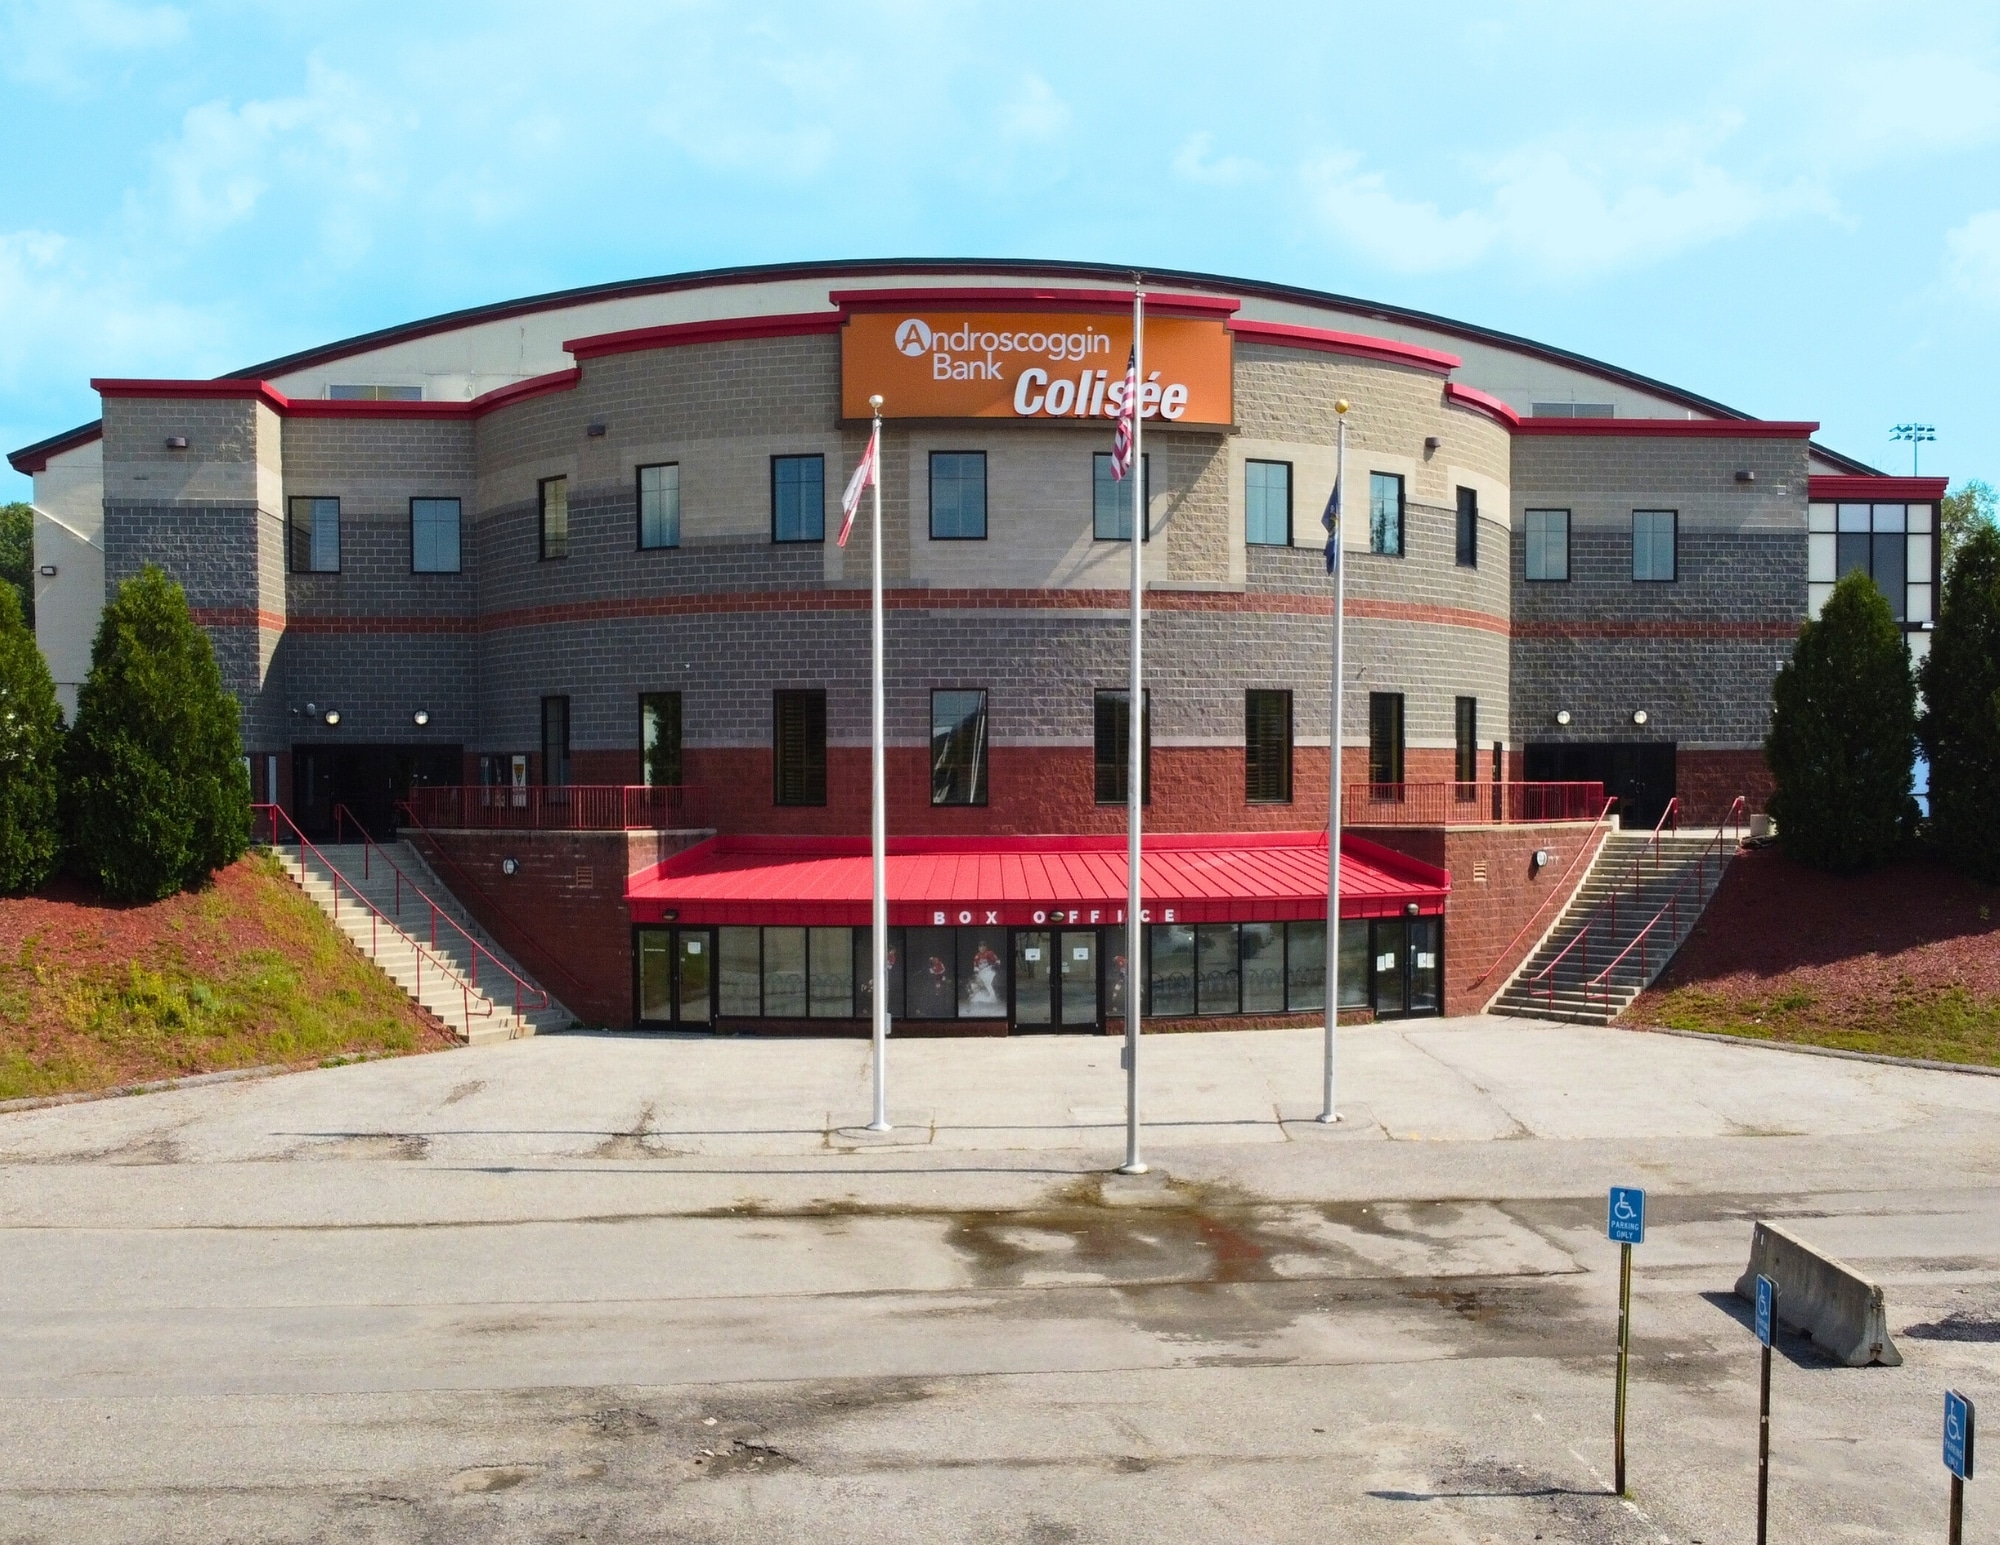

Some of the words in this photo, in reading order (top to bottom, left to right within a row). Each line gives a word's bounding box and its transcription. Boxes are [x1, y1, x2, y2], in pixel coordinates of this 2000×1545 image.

[895, 318, 1110, 362] Androscoggin
[933, 352, 1003, 380] Bank
[1013, 367, 1188, 419] Colisée
[934, 911, 997, 925] BOX
[1033, 909, 1174, 923] OFFICE
[1611, 1220, 1639, 1231] PARKING
[1616, 1231, 1633, 1239] ONLY
